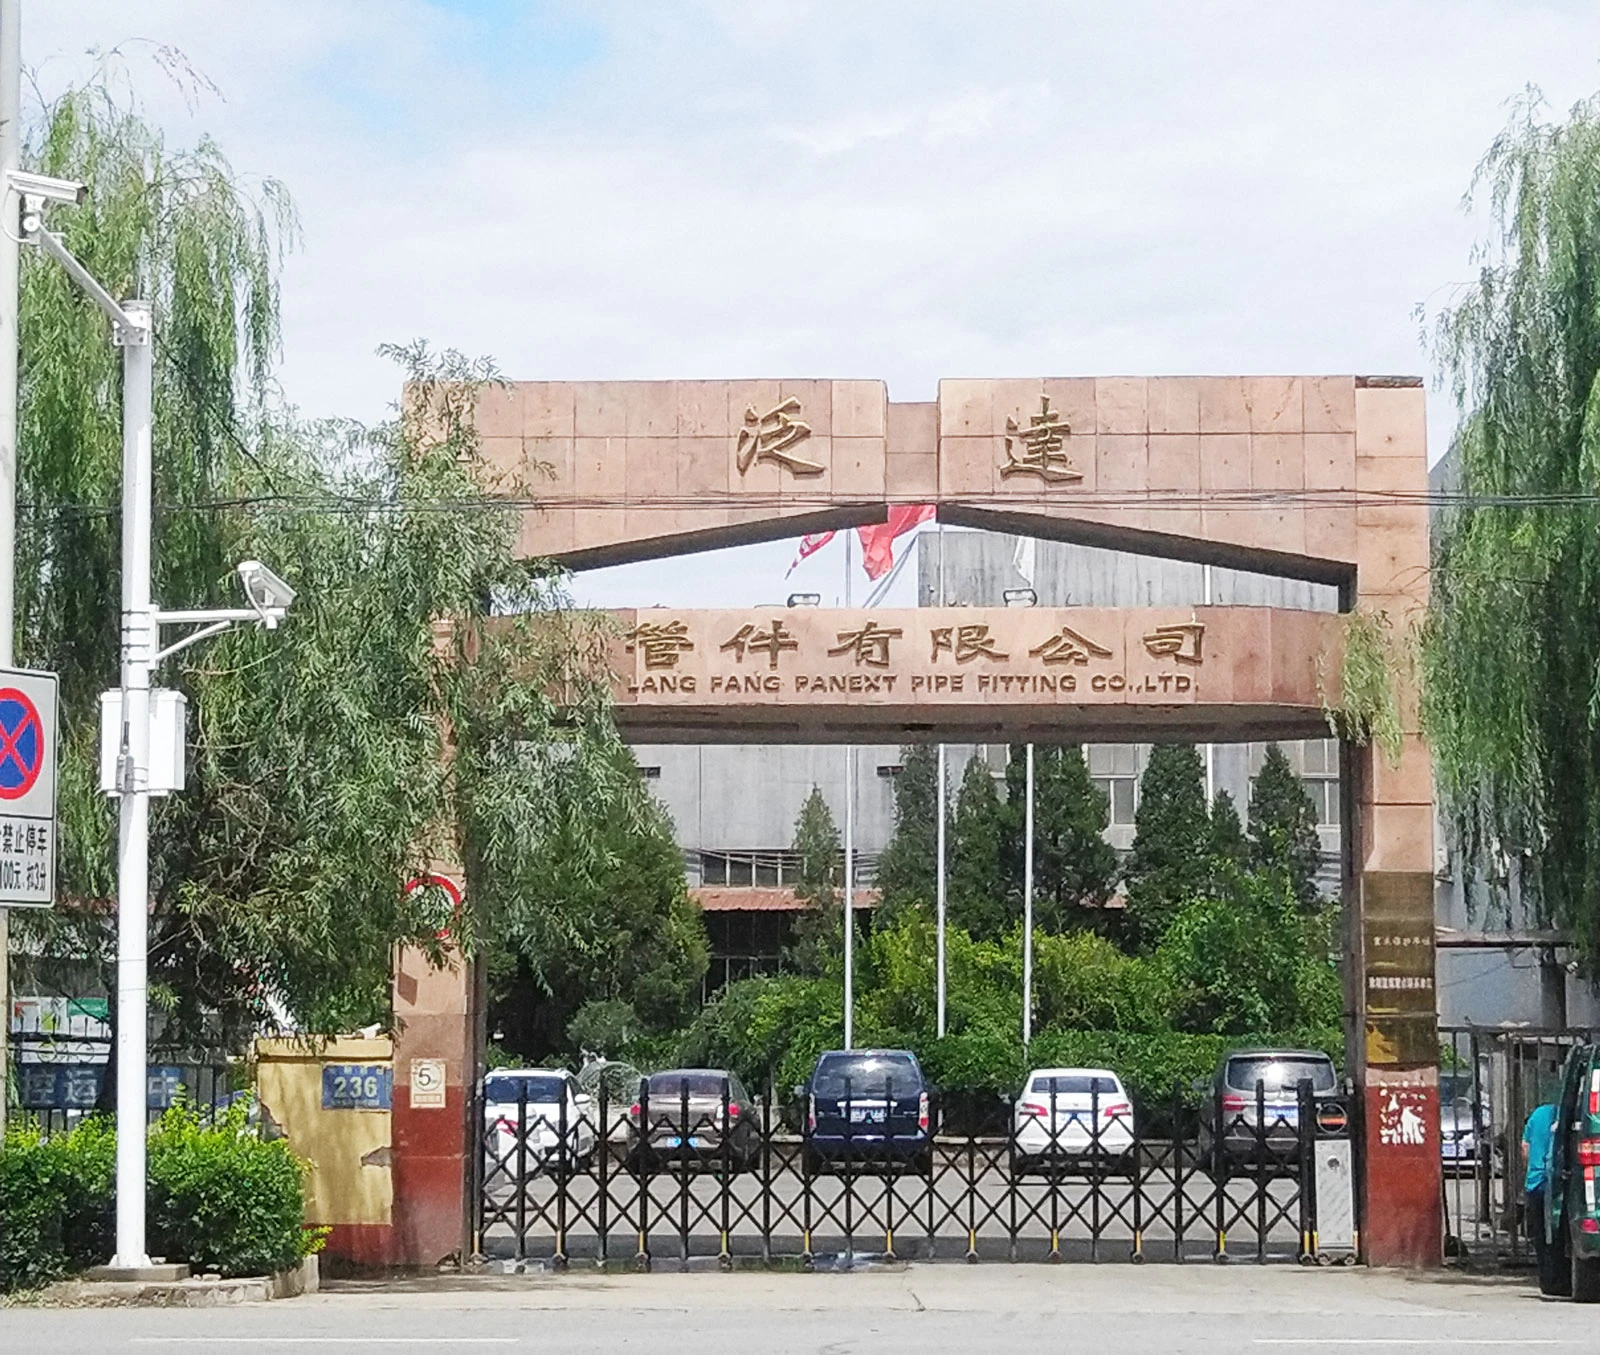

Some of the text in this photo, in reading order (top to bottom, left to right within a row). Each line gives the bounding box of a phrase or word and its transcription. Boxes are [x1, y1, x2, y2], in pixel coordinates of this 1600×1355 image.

[625, 618, 1206, 670] 管件有限公司
[710, 675, 781, 694] FANG
[795, 675, 898, 694] PANEXT
[911, 674, 965, 693] PIPE
[978, 674, 1077, 693] FITTING
[0, 823, 47, 857] 禁止停车
[333, 1076, 378, 1098] 236
[418, 1067, 431, 1087] 5
